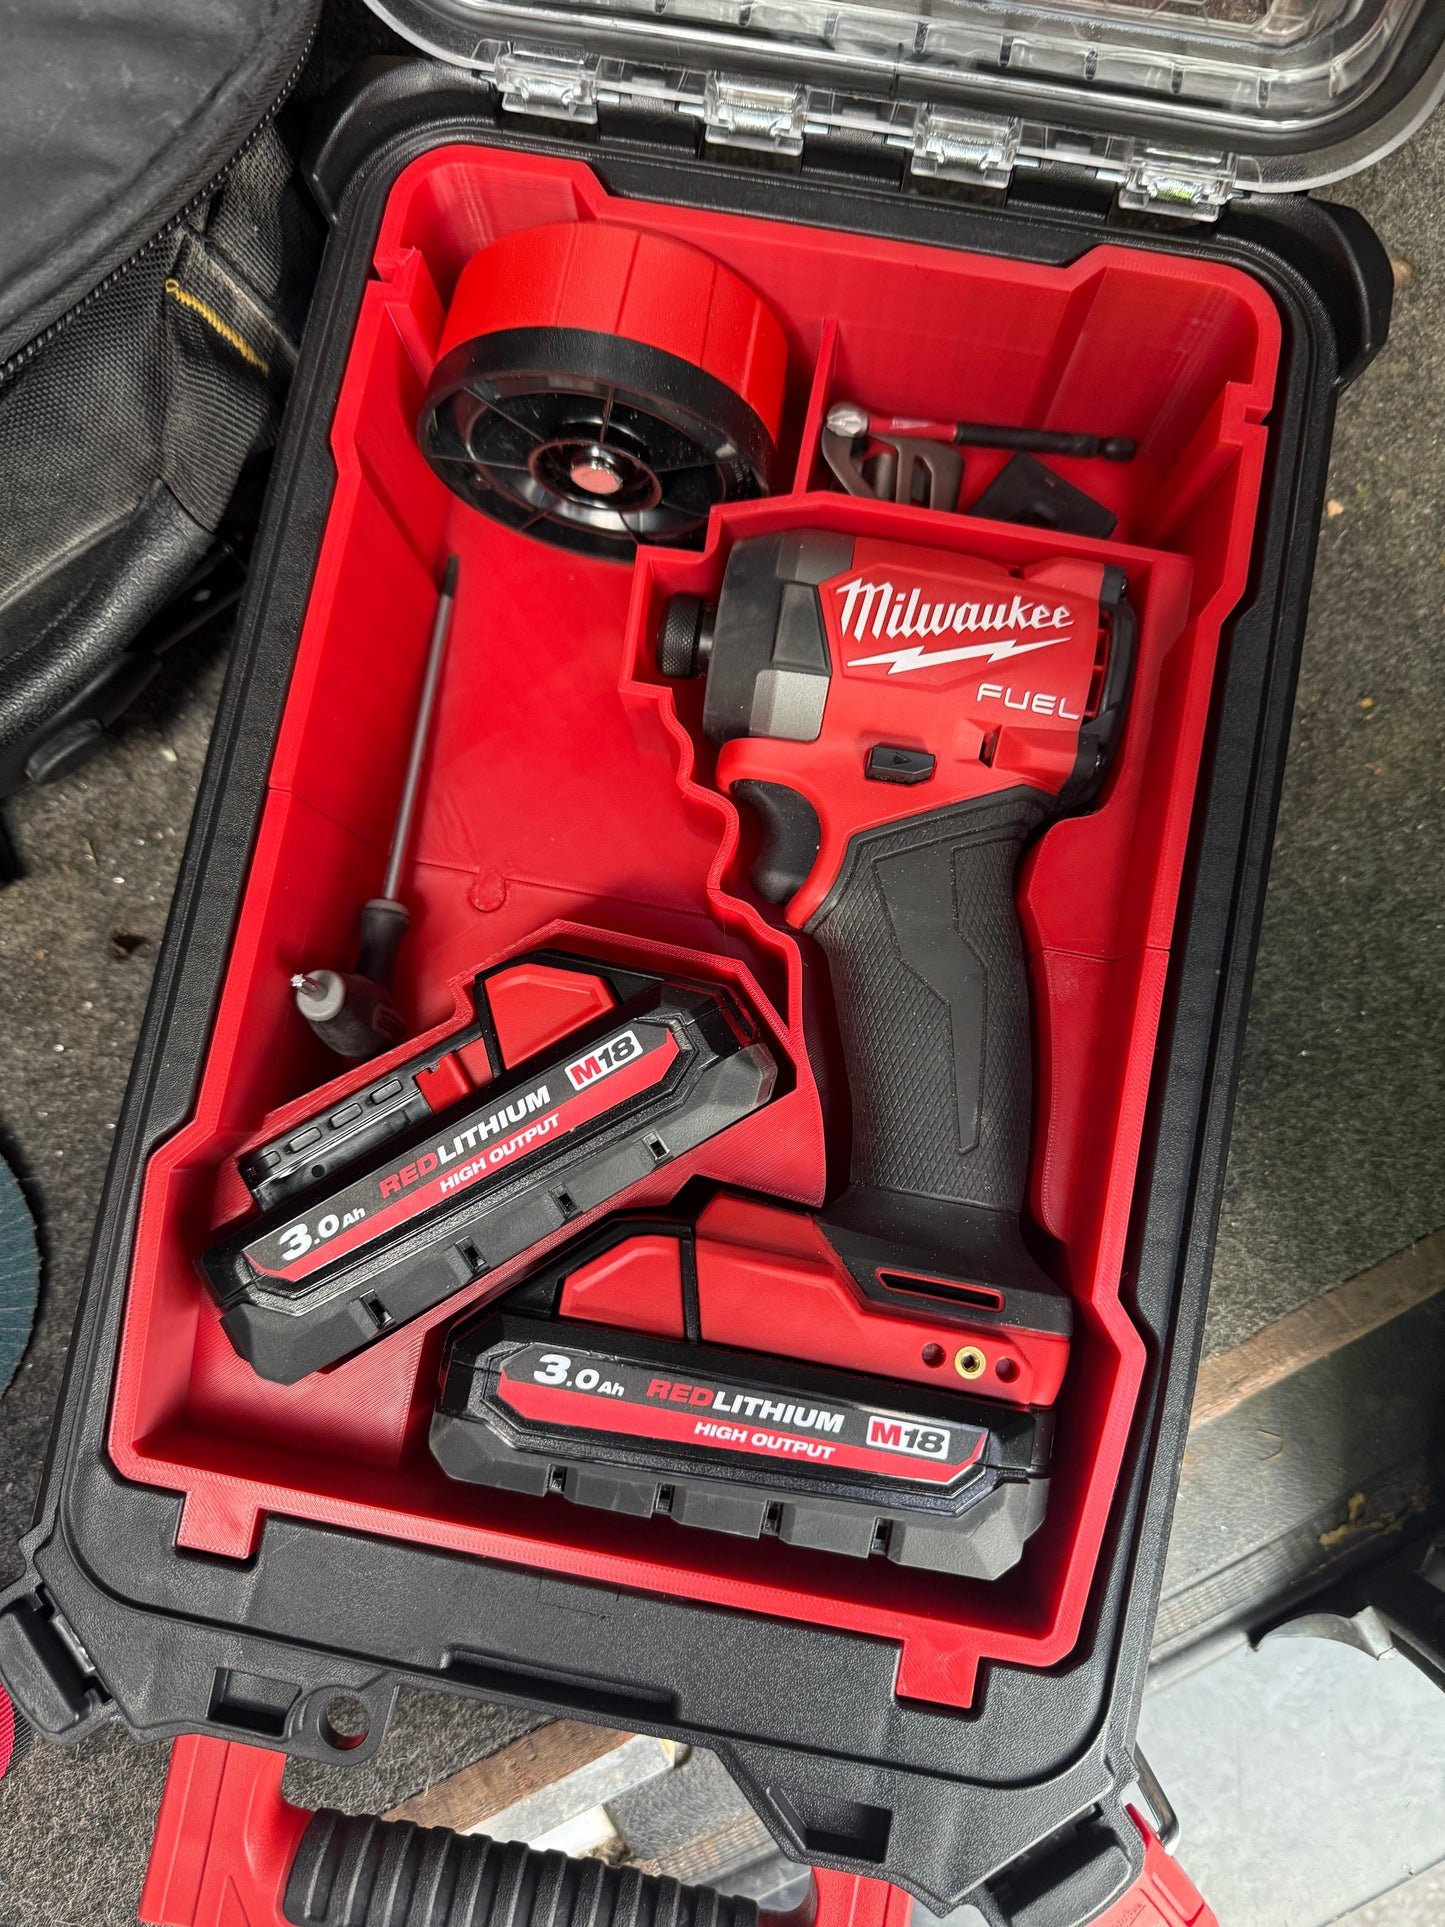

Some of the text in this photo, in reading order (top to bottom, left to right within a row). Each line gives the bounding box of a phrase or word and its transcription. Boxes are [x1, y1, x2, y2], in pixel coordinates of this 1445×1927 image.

[836, 577, 1074, 642] Milwaukee
[977, 683, 1080, 720] FUEL
[379, 1085, 551, 1199] REDLITHIUM
[570, 1036, 635, 1085] M18
[439, 1113, 560, 1193] HIGH OUTPUT
[646, 1378, 845, 1433] REDLITHIUM
[870, 1421, 946, 1453] M18
[694, 1421, 836, 1460] HIGH OUTPUT
